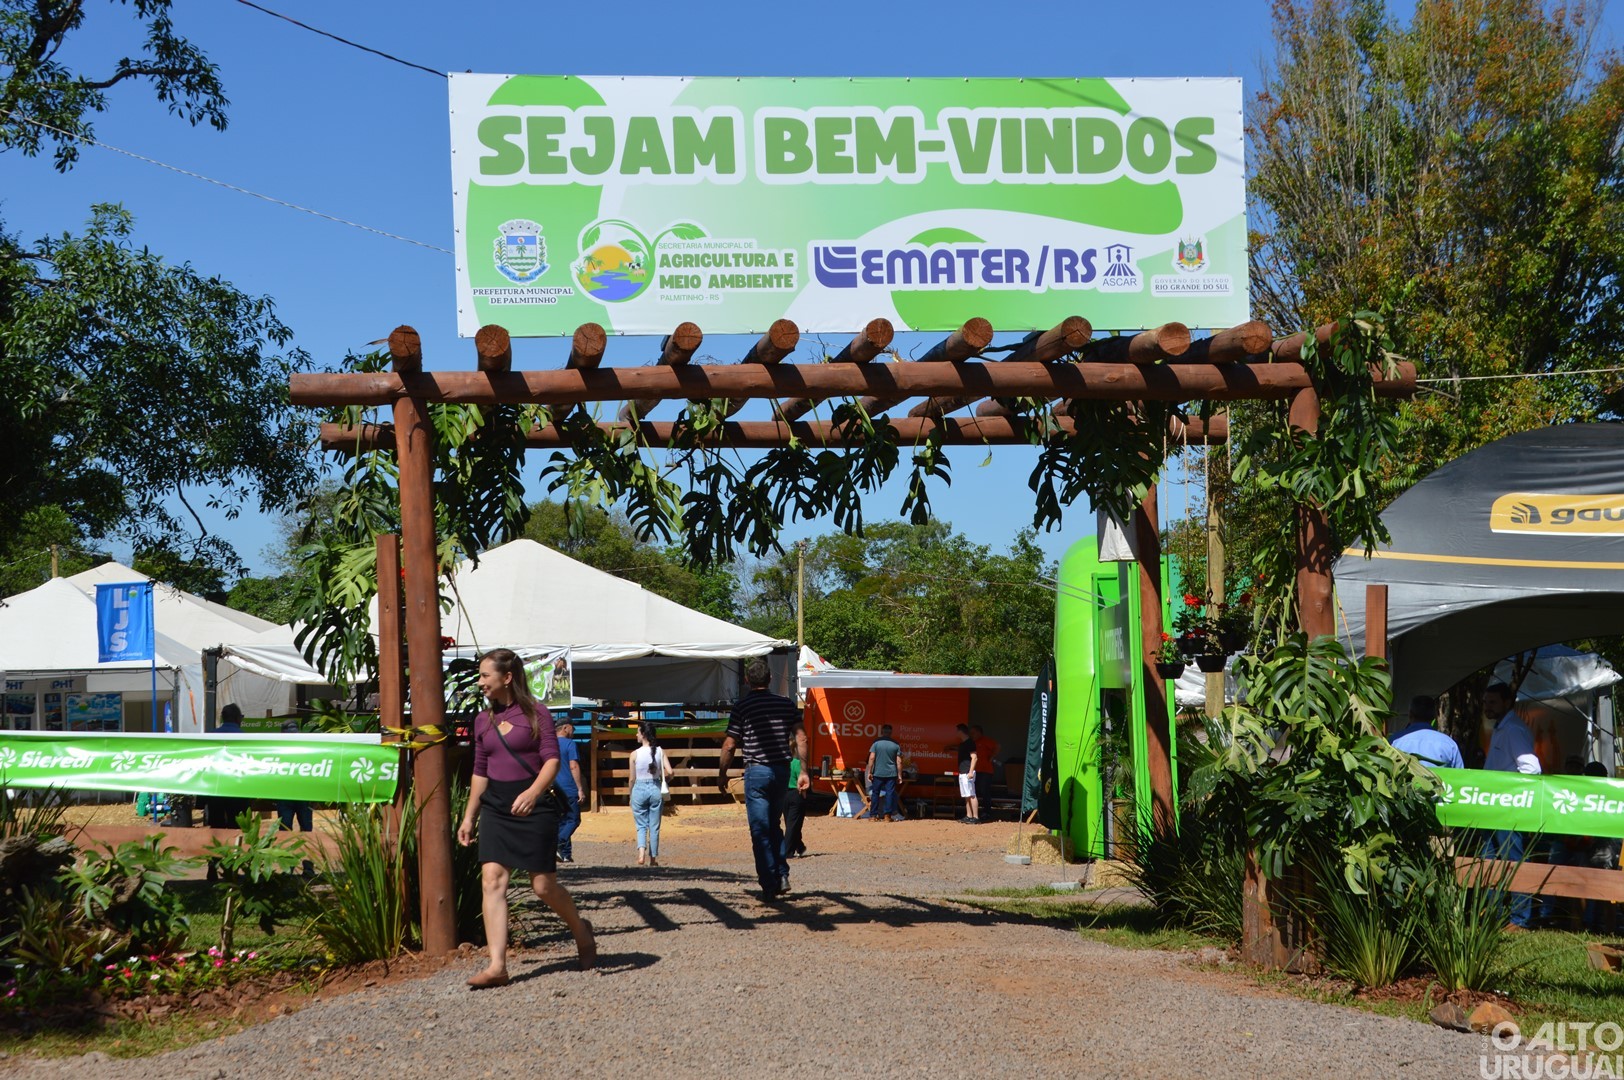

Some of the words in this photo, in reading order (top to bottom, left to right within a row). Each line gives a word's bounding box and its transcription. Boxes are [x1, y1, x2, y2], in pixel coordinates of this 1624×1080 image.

[477, 115, 736, 175] SEJAM
[764, 115, 1217, 175] BEM-VINDOS
[659, 253, 778, 268] AGRICULTURA
[784, 253, 794, 267] E
[861, 245, 1097, 287] EMATER/RS
[659, 274, 702, 289] MEIO
[708, 273, 794, 289] AMBIENTE
[1103, 278, 1137, 286] ASCAR
[901, 749, 953, 759] sibilidades.
[18, 750, 96, 769] Sicredi
[259, 757, 334, 778] Sicredi
[1458, 786, 1535, 808] Sicredi
